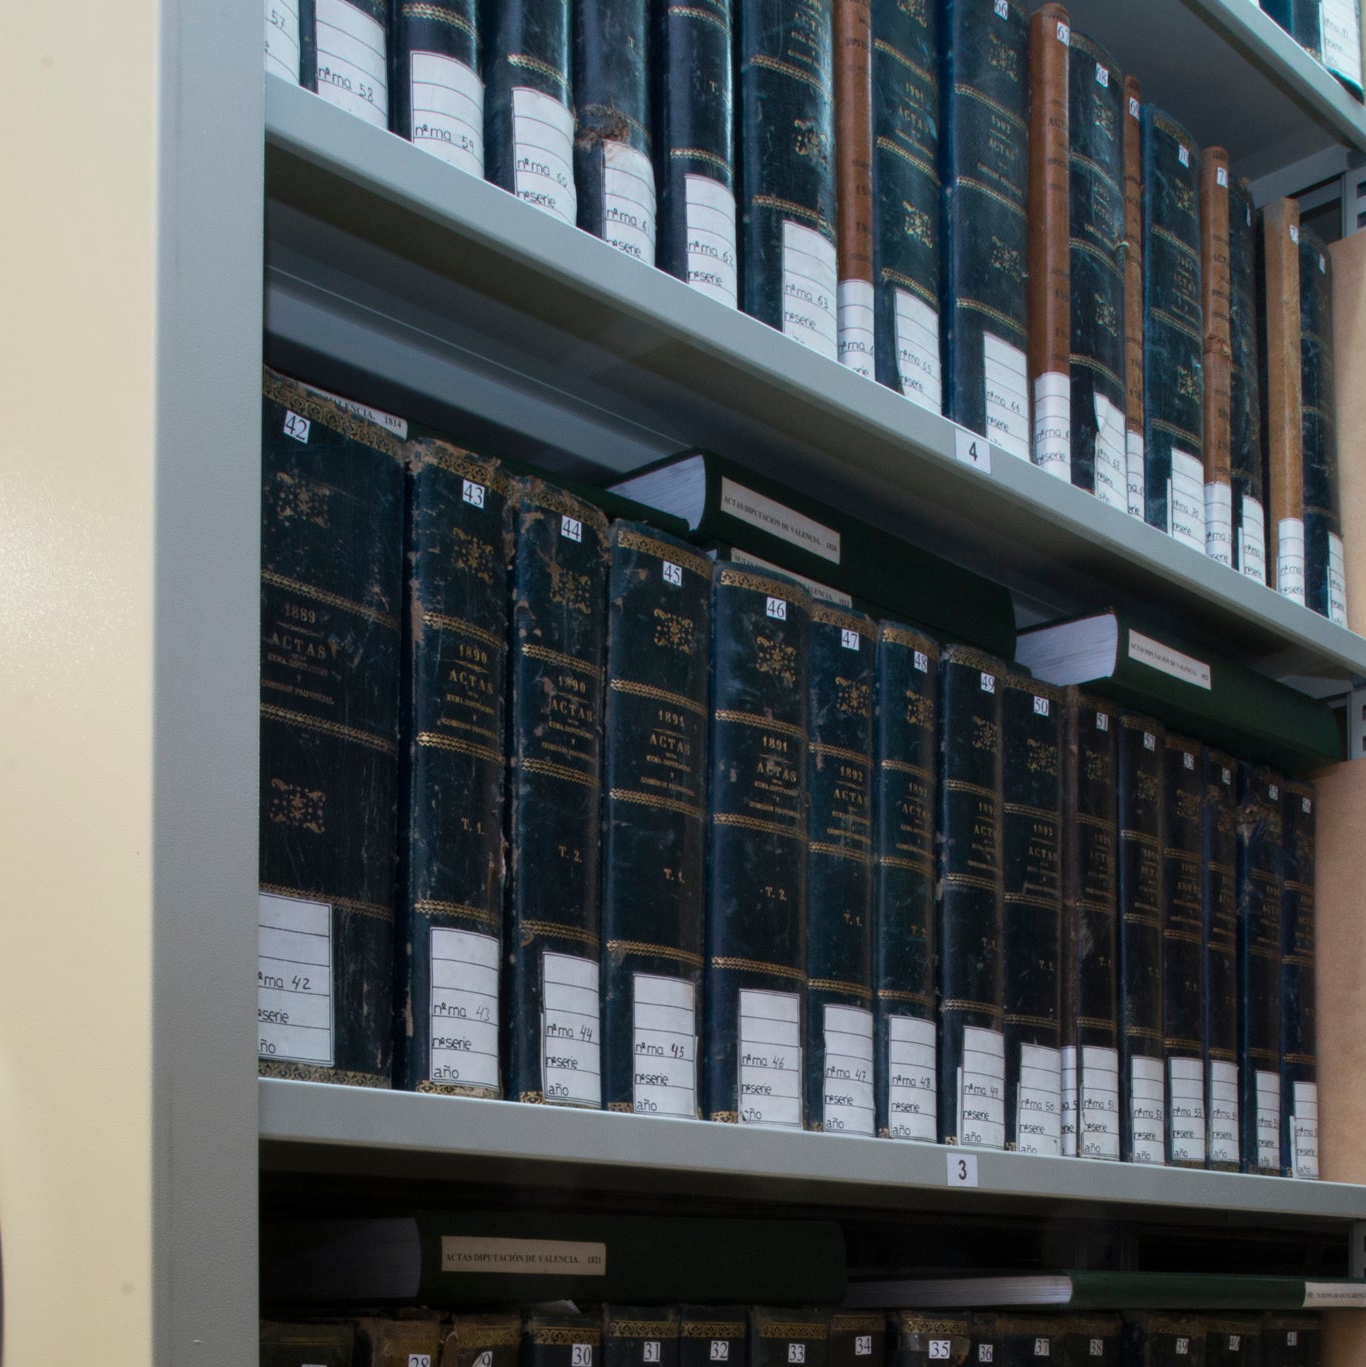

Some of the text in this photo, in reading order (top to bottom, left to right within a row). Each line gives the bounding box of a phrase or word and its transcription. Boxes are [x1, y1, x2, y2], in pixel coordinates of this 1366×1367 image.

[1058, 22, 1070, 44] 67
[1096, 64, 1109, 87] 68
[285, 415, 308, 442] 42
[969, 441, 978, 462] 4
[463, 484, 483, 506] 43
[725, 496, 744, 513] ACTAS
[562, 518, 581, 540] 44
[664, 563, 682, 585] 45
[284, 605, 316, 625] 1889
[767, 599, 785, 618] 46
[270, 631, 326, 660] ACTAS
[842, 632, 858, 650] 47
[459, 645, 487, 664] 1890
[915, 652, 928, 672] 48
[449, 669, 494, 696] ACTAS
[558, 675, 586, 693] 1890
[981, 674, 995, 693] 49
[550, 698, 595, 722] ACTAS
[1035, 698, 1049, 716] 50
[658, 709, 684, 727] 1891
[1096, 714, 1108, 732] 51
[650, 733, 691, 757] ACTAS
[762, 735, 788, 753] 1891
[1144, 733, 1155, 751] 52
[757, 762, 797, 783] ACTAS
[839, 765, 864, 783] 1892
[291, 975, 313, 991] 42
[476, 1004, 491, 1022] 43
[579, 1025, 594, 1042] 44
[671, 1043, 685, 1059] 45
[772, 1056, 785, 1070] 46
[855, 1068, 867, 1082] 47
[920, 1076, 931, 1090] 48
[958, 1159, 968, 1181] 3
[446, 1252, 473, 1263] ACTAS
[644, 1343, 660, 1361] 31
[711, 1342, 729, 1360] 32
[789, 1344, 804, 1362] 33
[856, 1338, 871, 1354] 34
[930, 1342, 949, 1358] 35
[980, 1345, 993, 1361] 36
[1035, 1339, 1049, 1355] 37
[573, 1346, 592, 1365] 30
